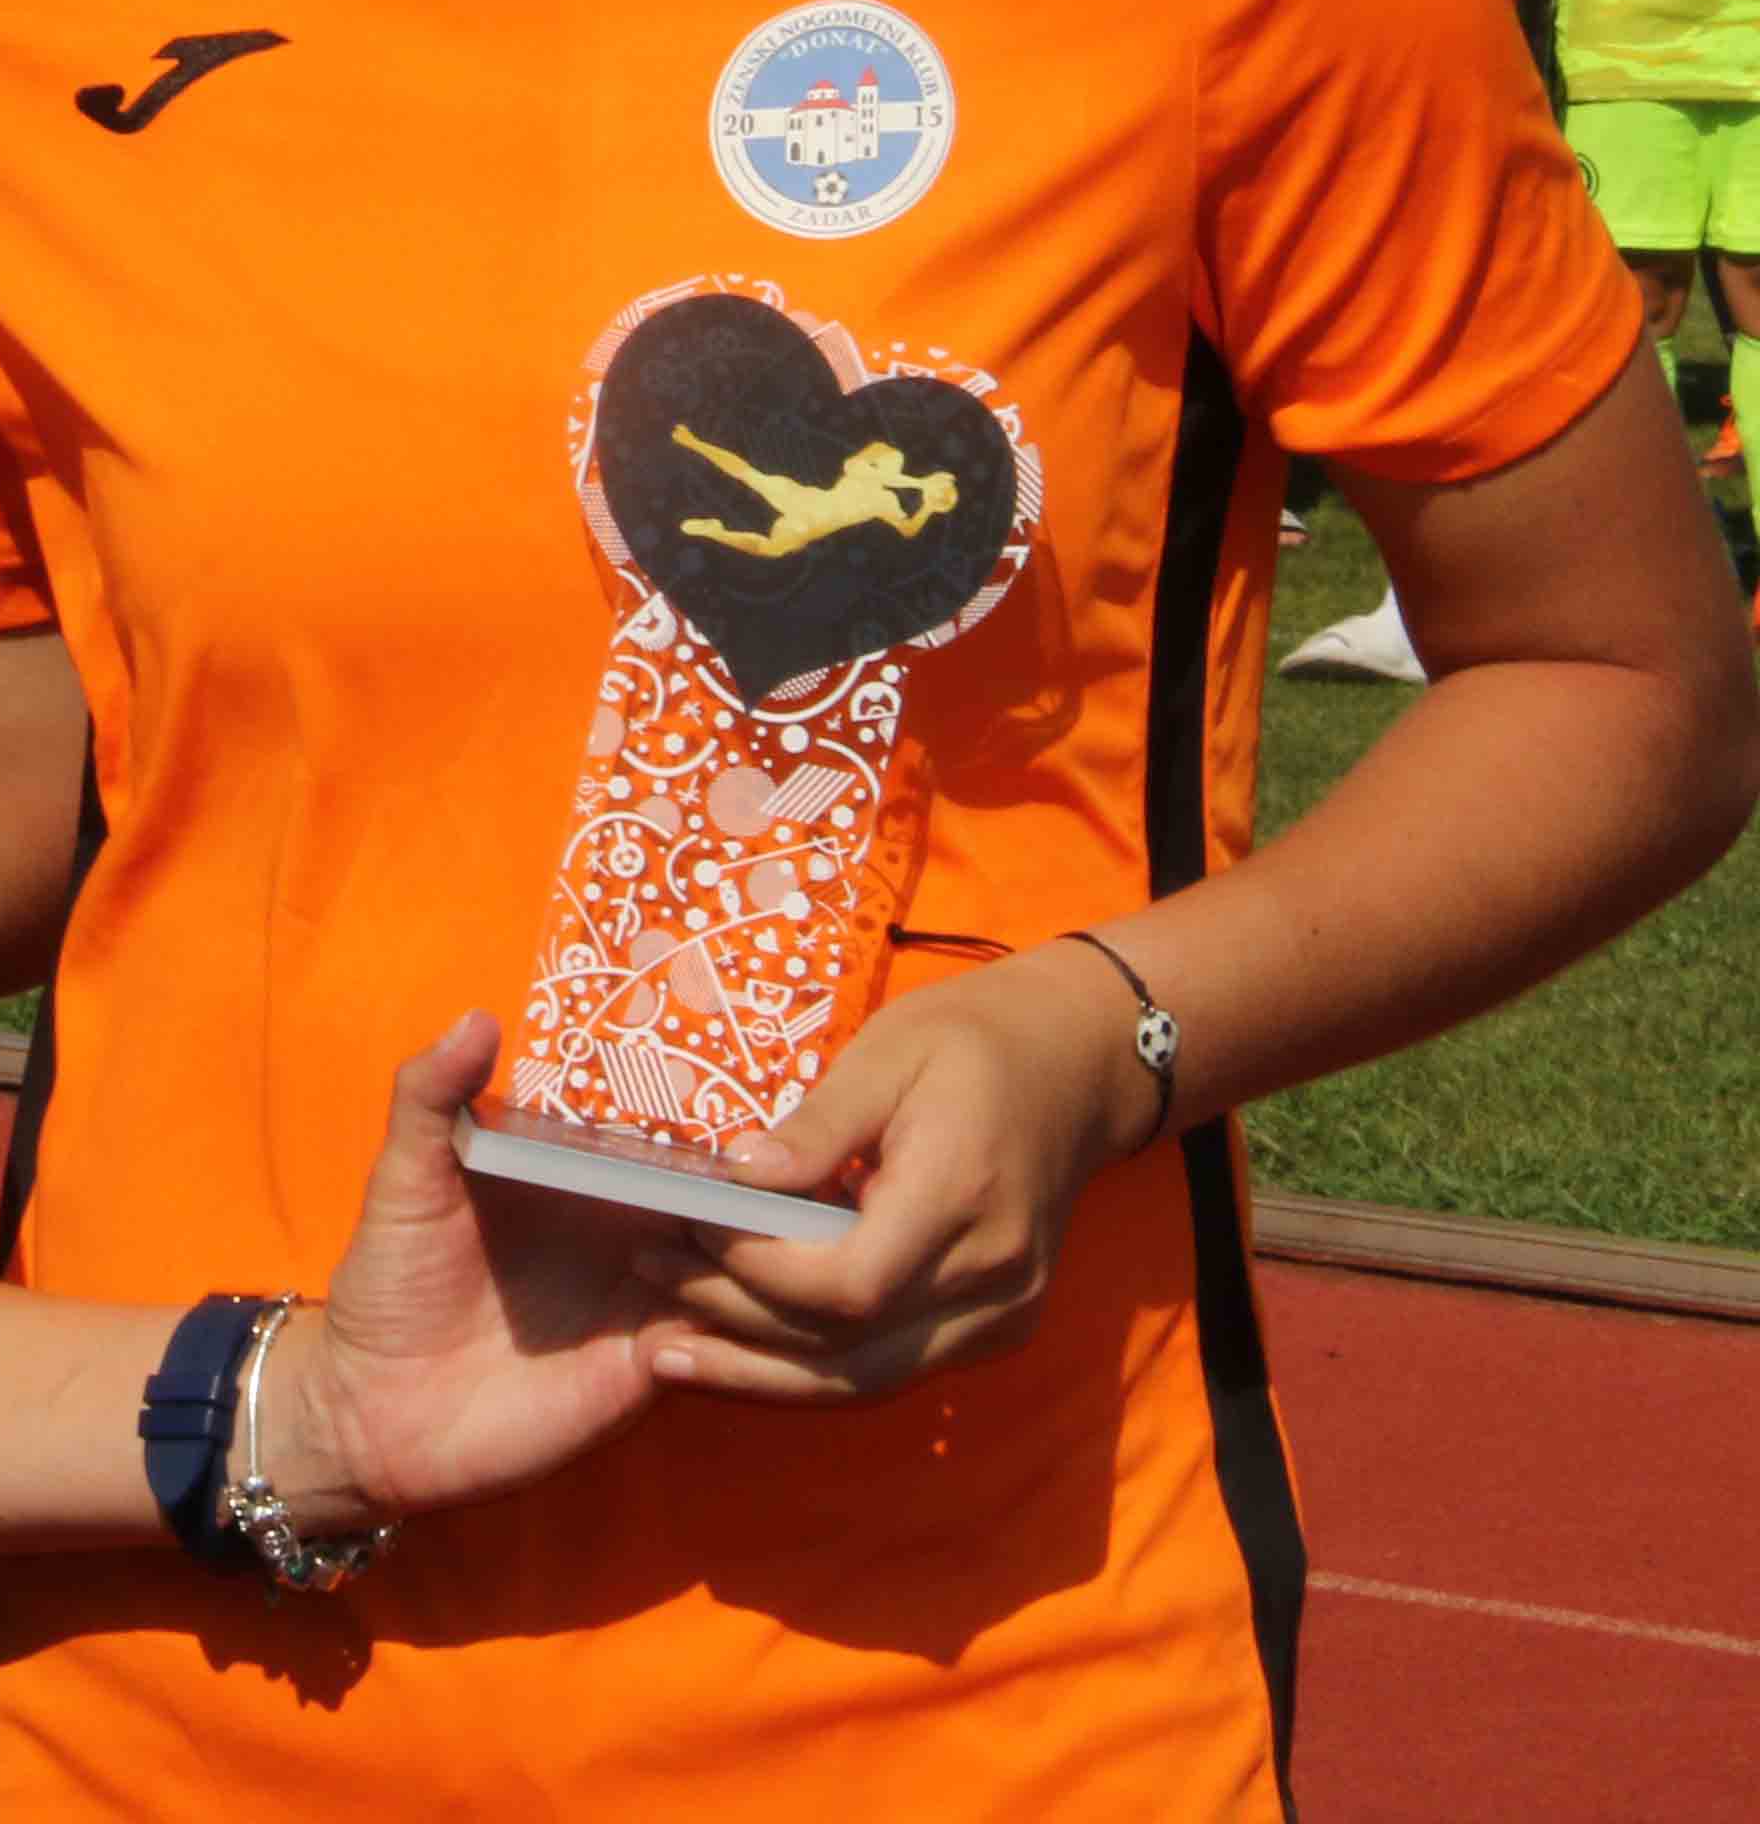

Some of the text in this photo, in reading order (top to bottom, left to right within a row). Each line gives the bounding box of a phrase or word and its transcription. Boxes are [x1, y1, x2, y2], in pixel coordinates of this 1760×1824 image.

[723, 105, 943, 137] 20 15
[789, 205, 874, 227] ZADAR
